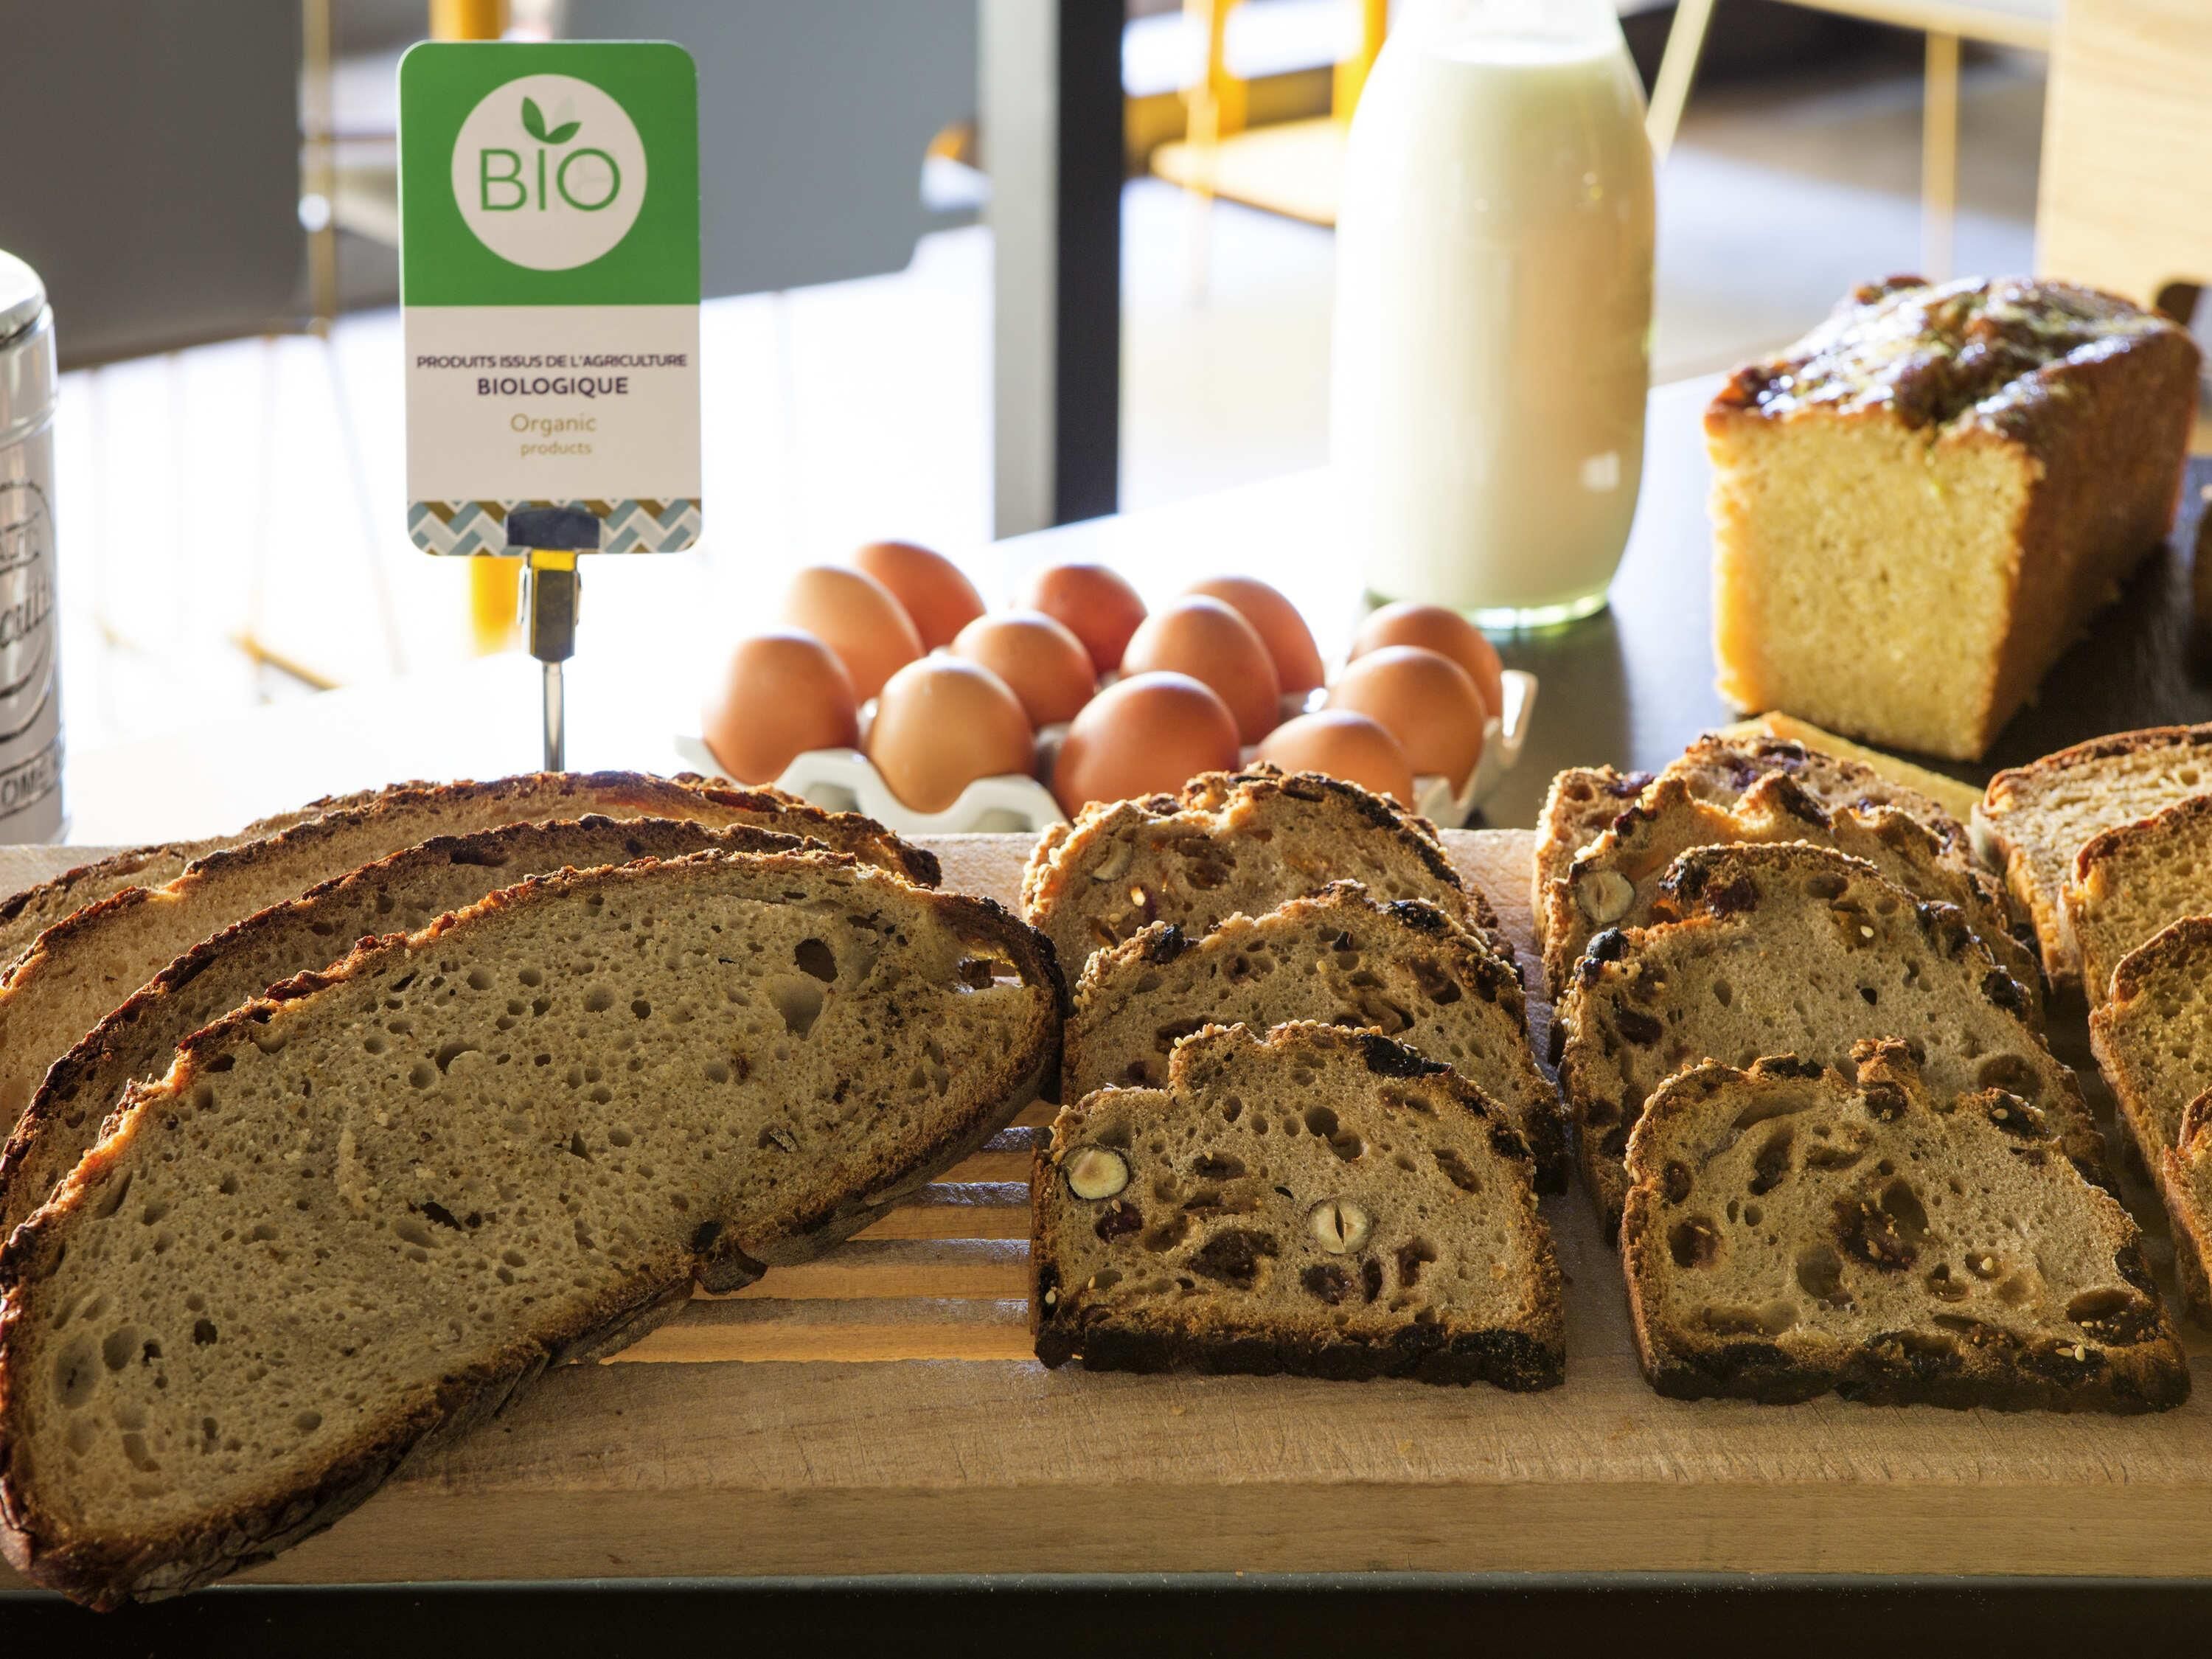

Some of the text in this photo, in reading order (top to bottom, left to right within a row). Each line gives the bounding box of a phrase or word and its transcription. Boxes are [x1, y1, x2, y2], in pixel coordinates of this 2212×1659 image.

[481, 147, 621, 212] BIO
[417, 354, 687, 369] PRODUITS ISSUS DE L'AGRICULTURE
[477, 376, 629, 398] BIOLOGIQUE
[509, 412, 597, 437] Organic
[520, 441, 593, 456] products
